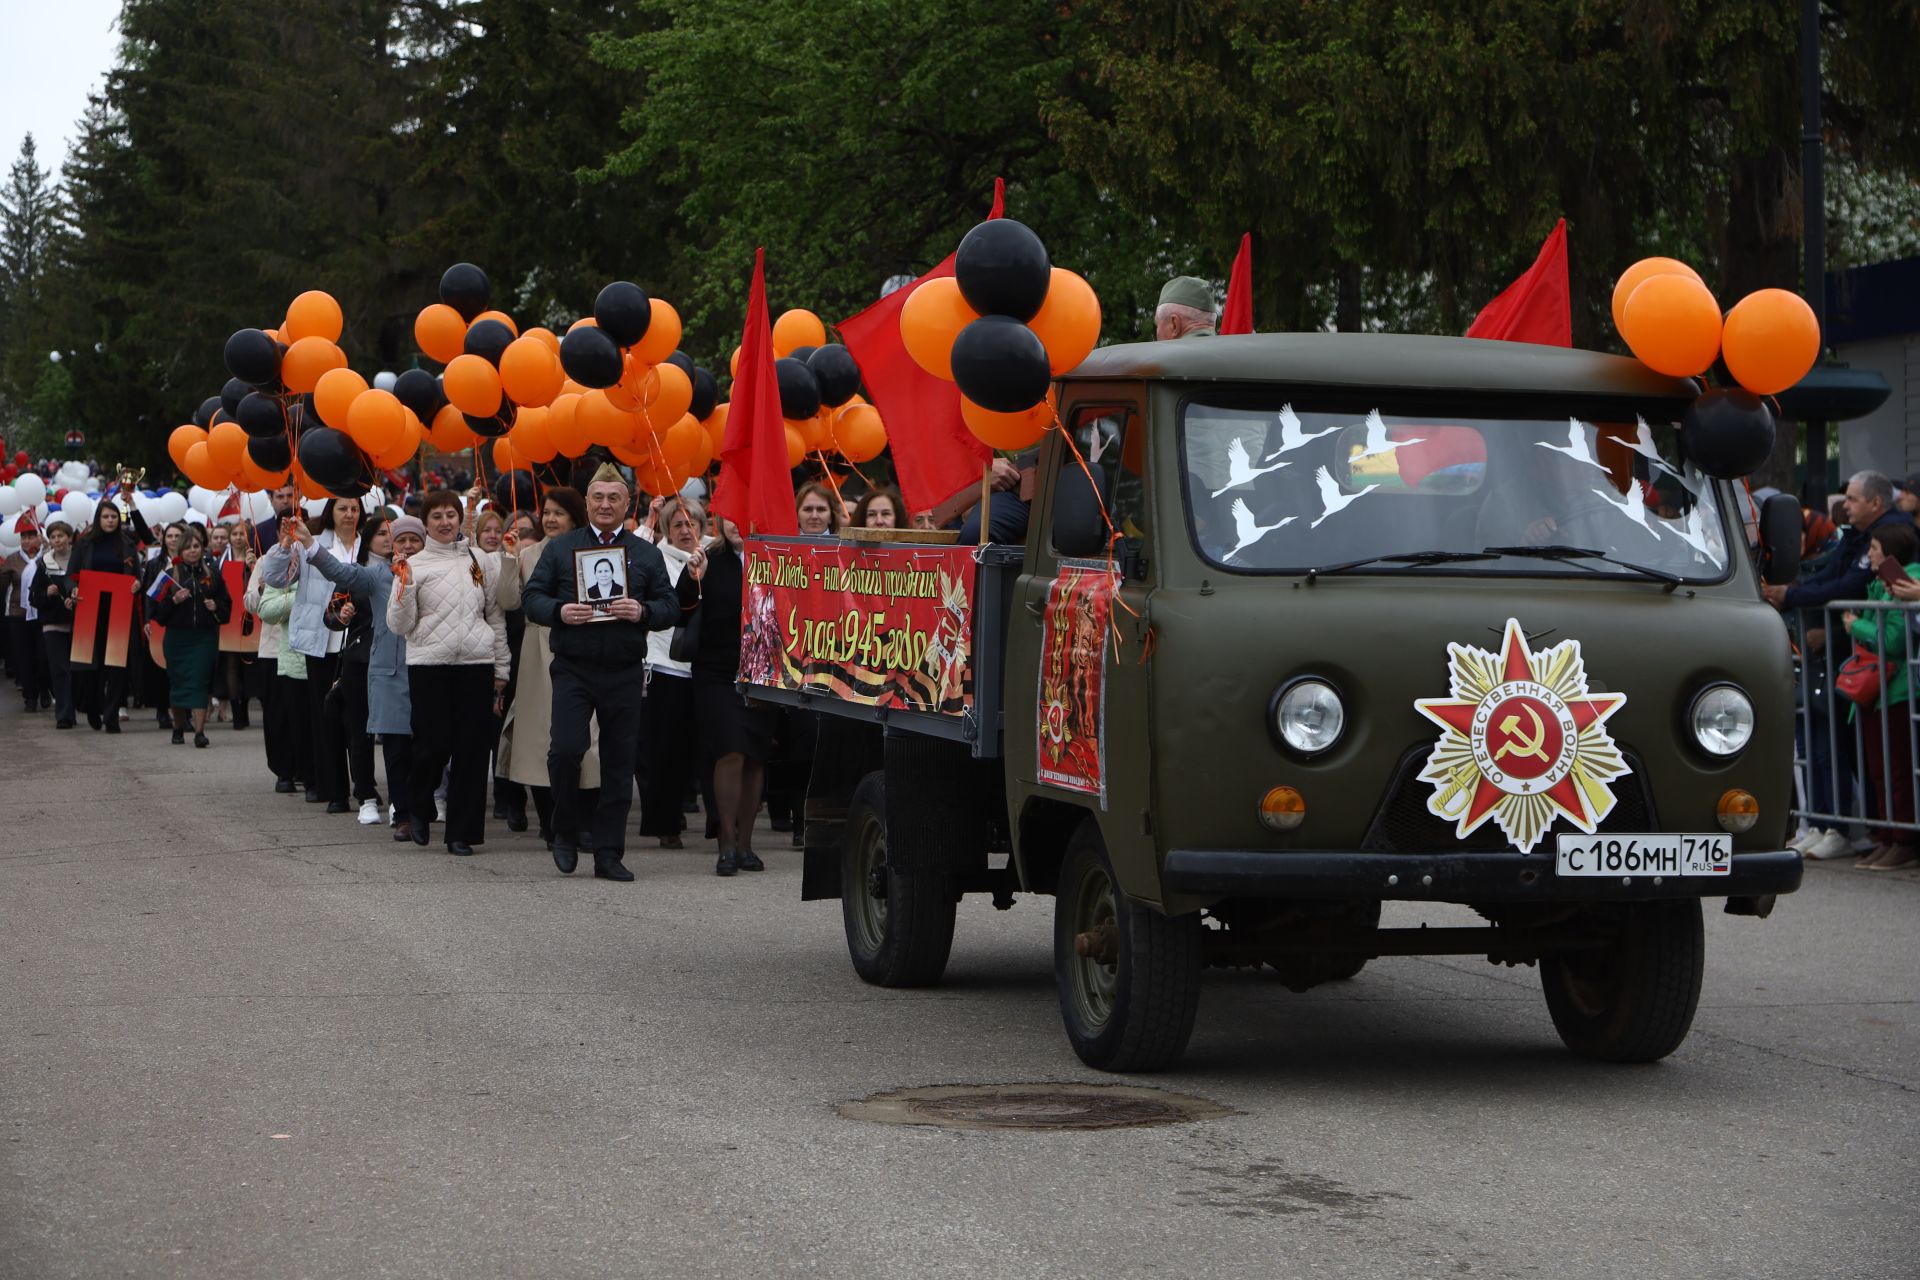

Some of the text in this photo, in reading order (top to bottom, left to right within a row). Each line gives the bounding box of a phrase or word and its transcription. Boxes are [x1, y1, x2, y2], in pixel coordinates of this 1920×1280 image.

[838, 609, 885, 668] 1945
[1472, 682, 1565, 784] ОТЕЧЕСТВЕННАЯ
[1568, 839, 1724, 872] С186МН 716
[1692, 863, 1712, 871] RUS
